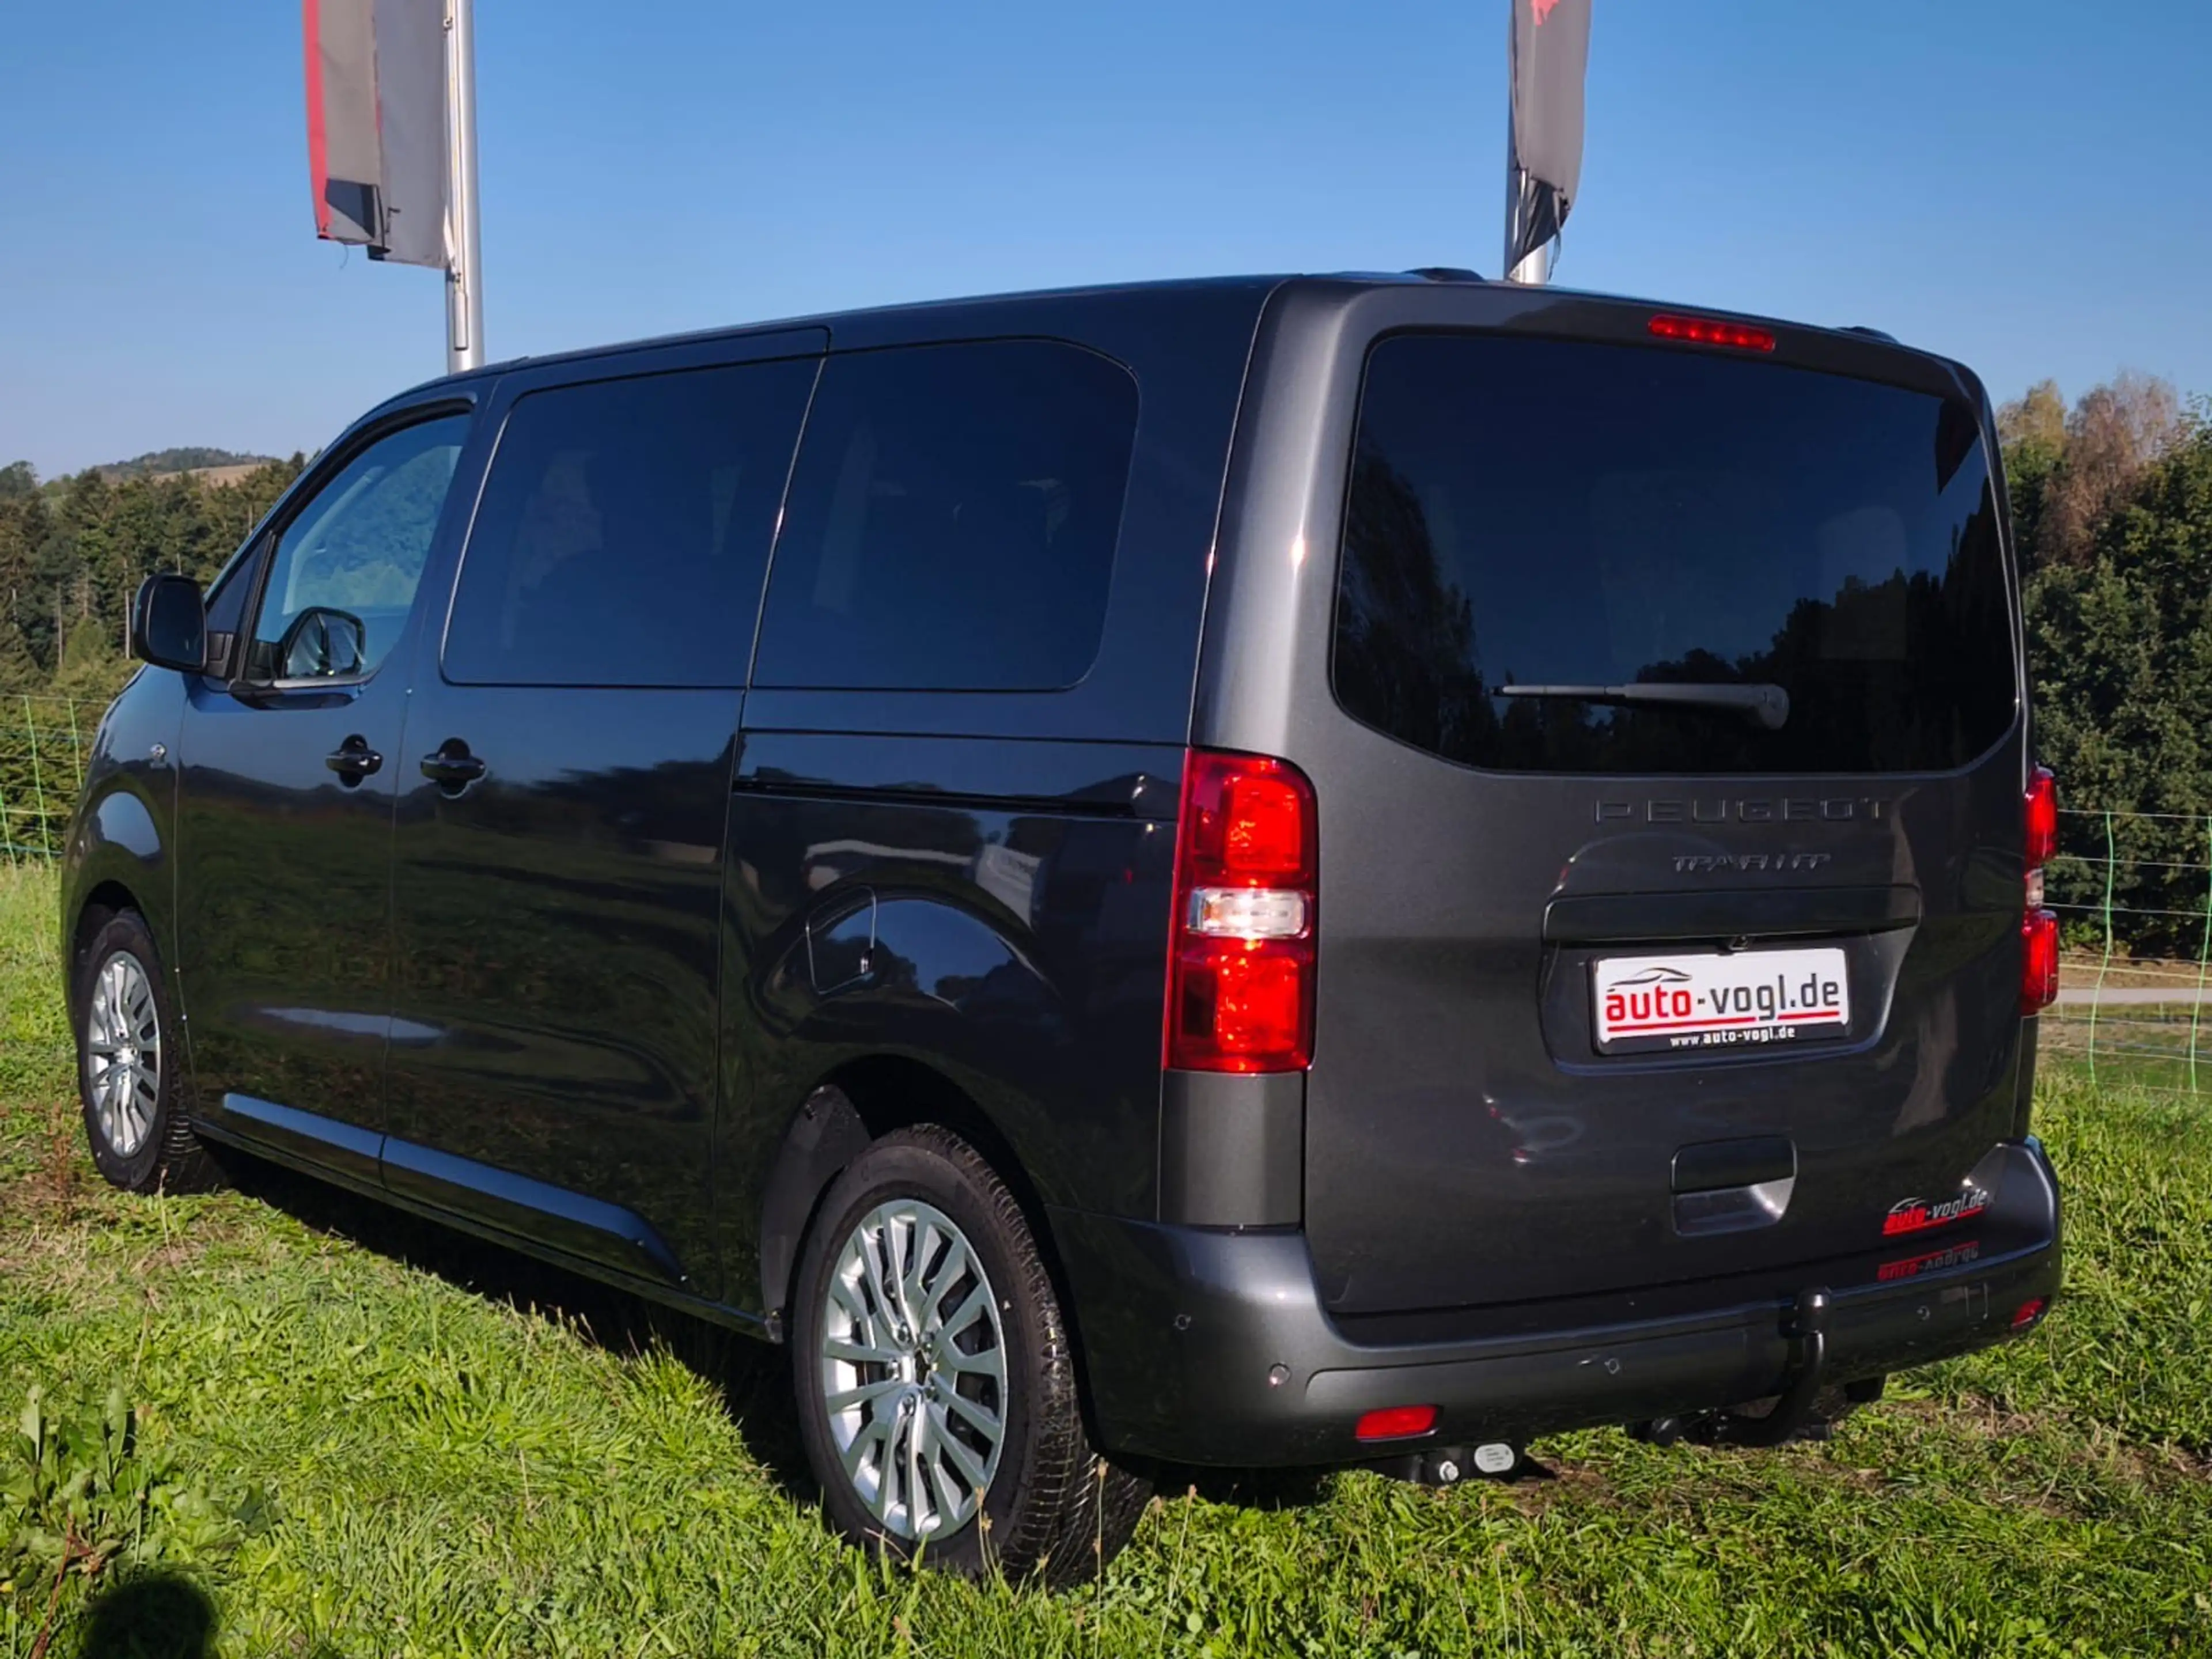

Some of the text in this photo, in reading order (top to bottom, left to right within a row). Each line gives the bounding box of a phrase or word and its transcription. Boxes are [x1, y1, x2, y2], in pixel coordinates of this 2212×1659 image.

[1593, 798, 1891, 824] PEUGEOT
[1606, 974, 1840, 1020] auto-vogl.de
[1670, 1025, 1796, 1047] www.auto-vogl.de
[1883, 1188, 1987, 1231] auto-vogl.de
